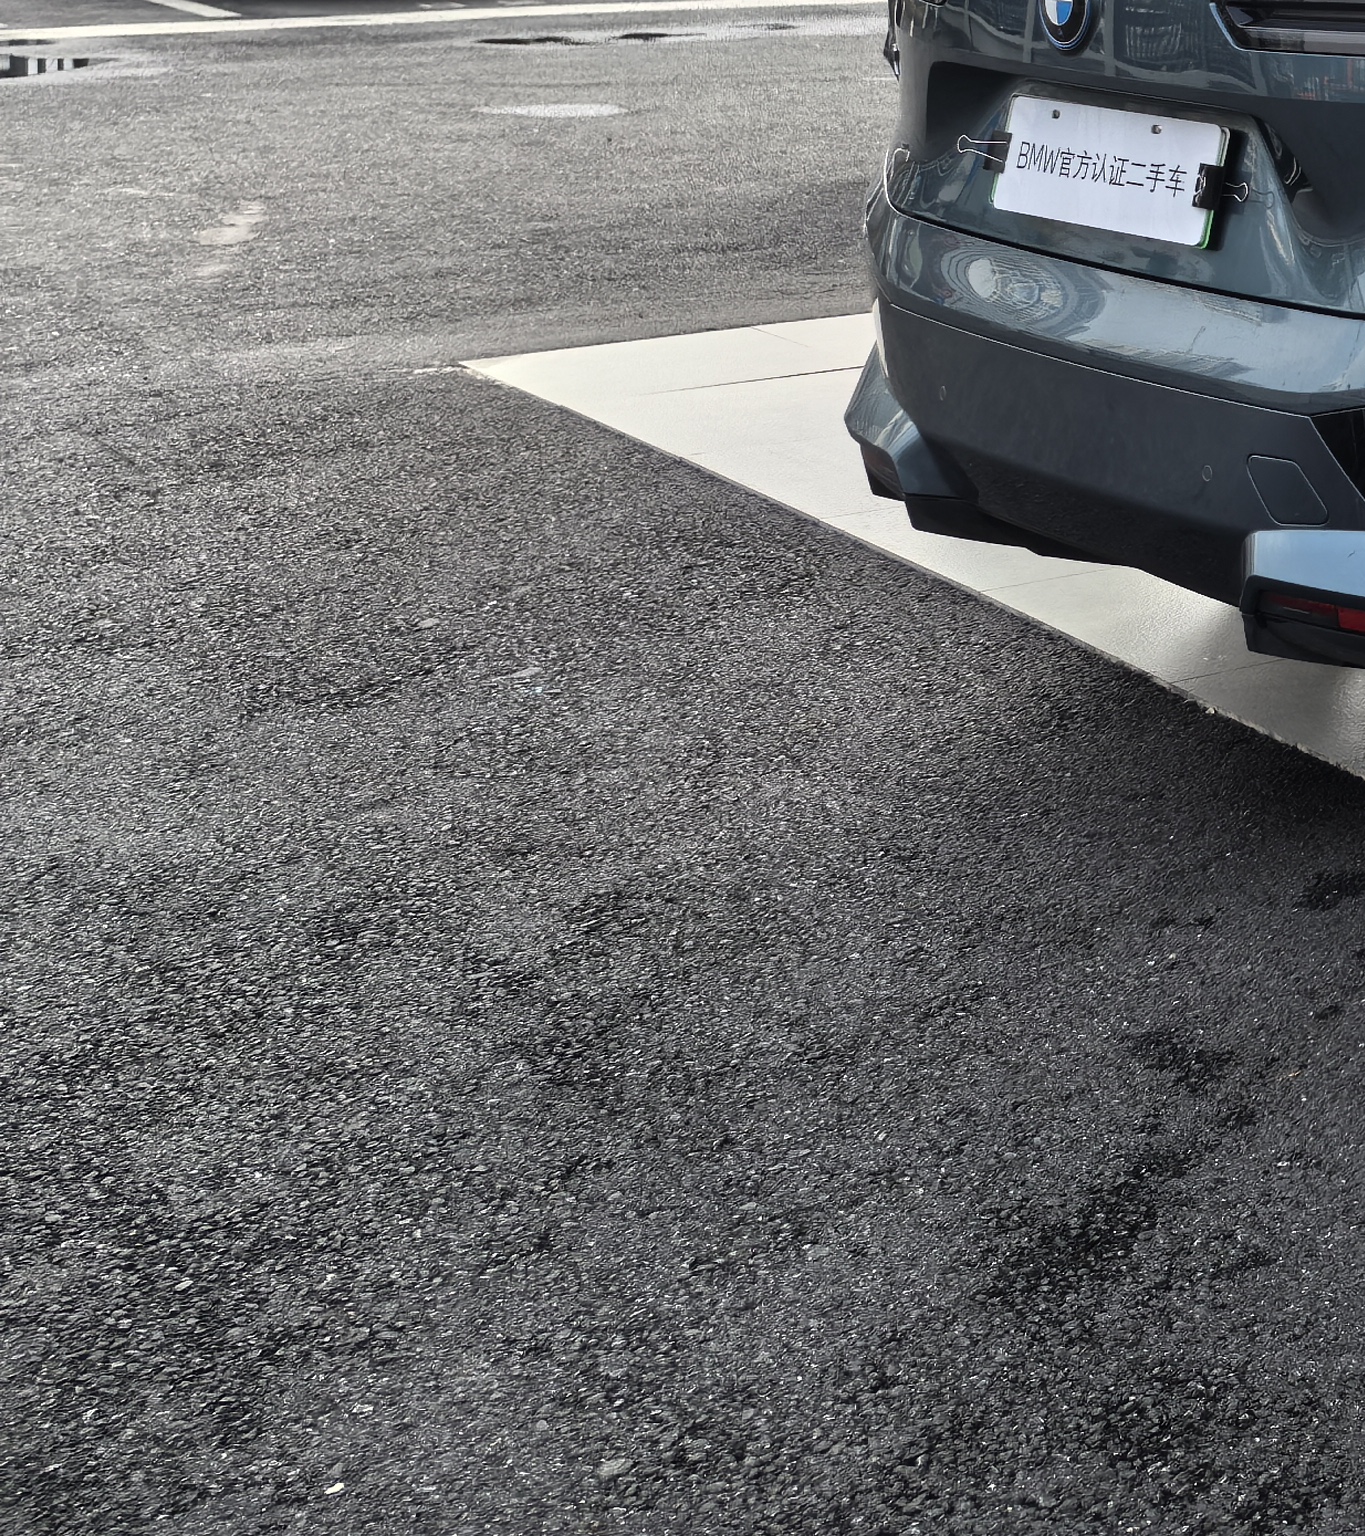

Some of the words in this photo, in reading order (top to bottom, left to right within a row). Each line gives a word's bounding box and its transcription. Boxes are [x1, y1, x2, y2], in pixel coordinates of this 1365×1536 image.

[1016, 141, 1187, 198] BMW官方认证二手车
